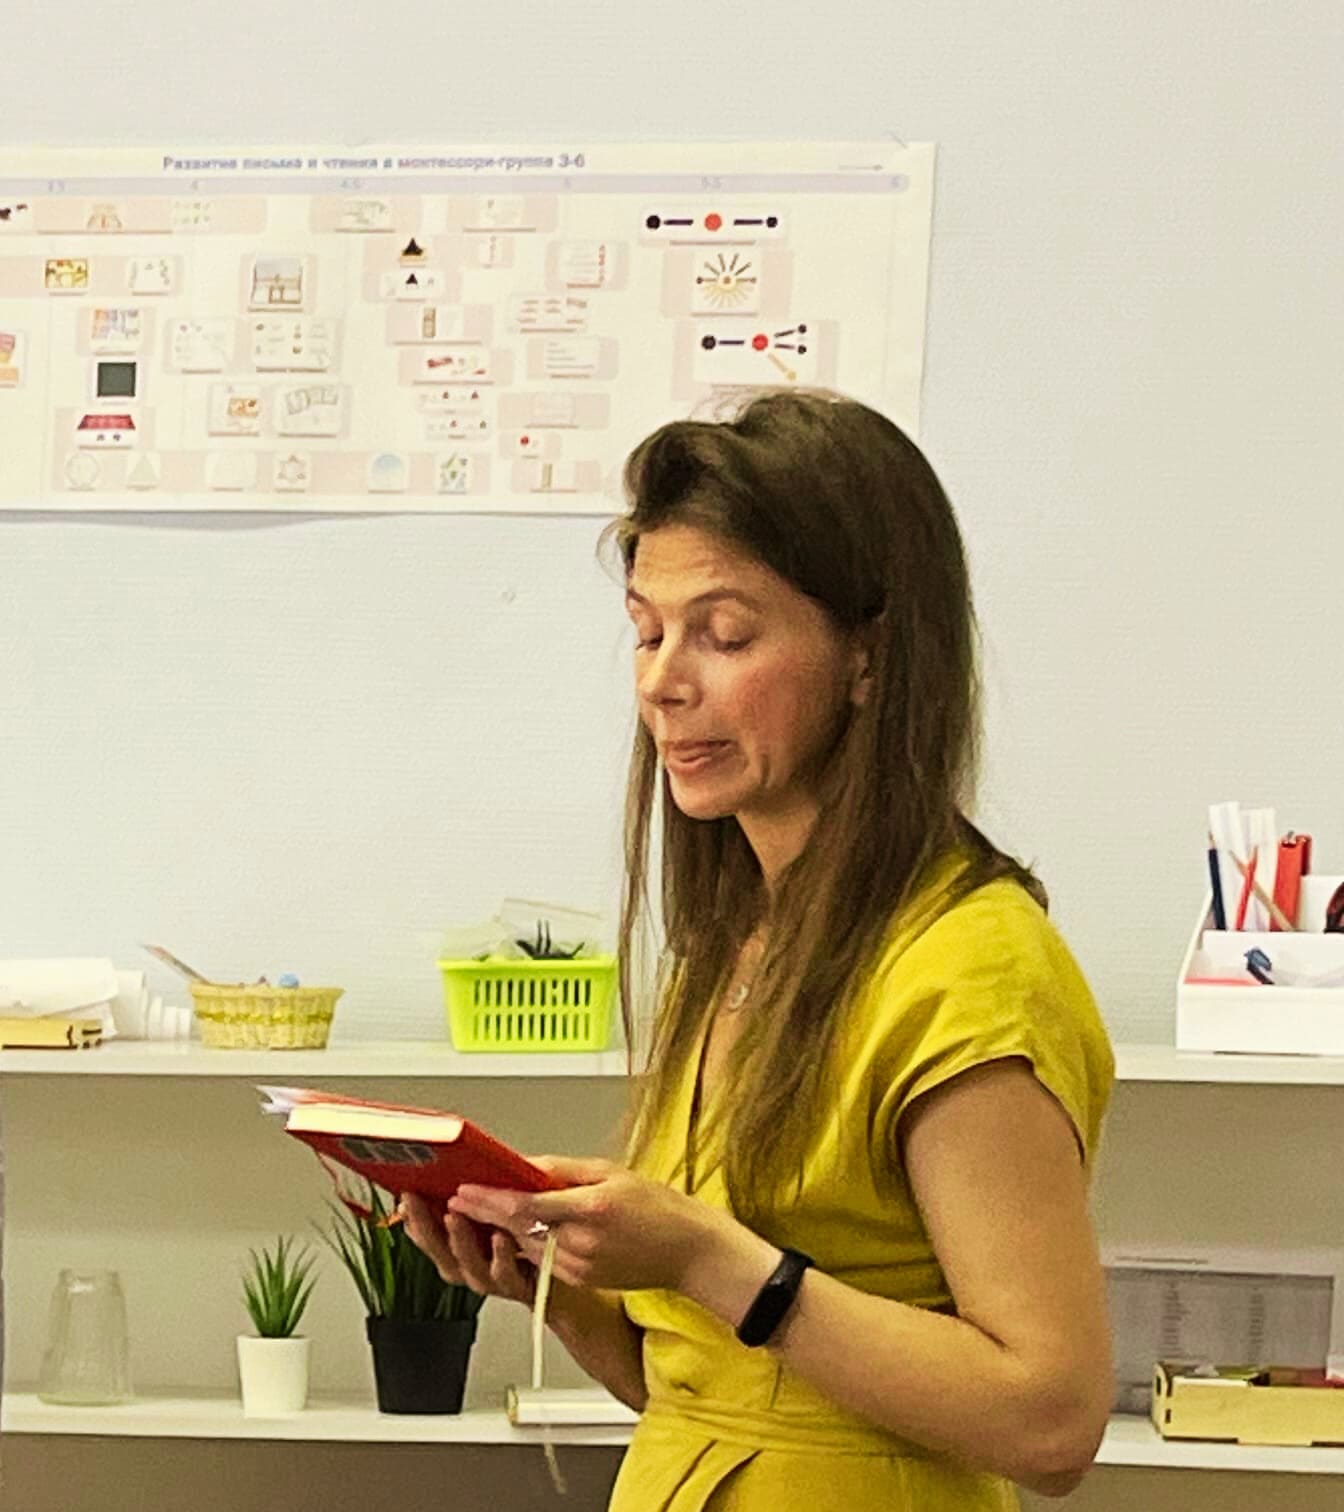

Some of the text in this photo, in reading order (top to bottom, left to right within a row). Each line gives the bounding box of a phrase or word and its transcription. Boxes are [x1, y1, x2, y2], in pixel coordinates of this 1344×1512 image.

[162, 156, 238, 171] Развитие
[307, 157, 318, 169] и
[322, 156, 378, 169] чтения
